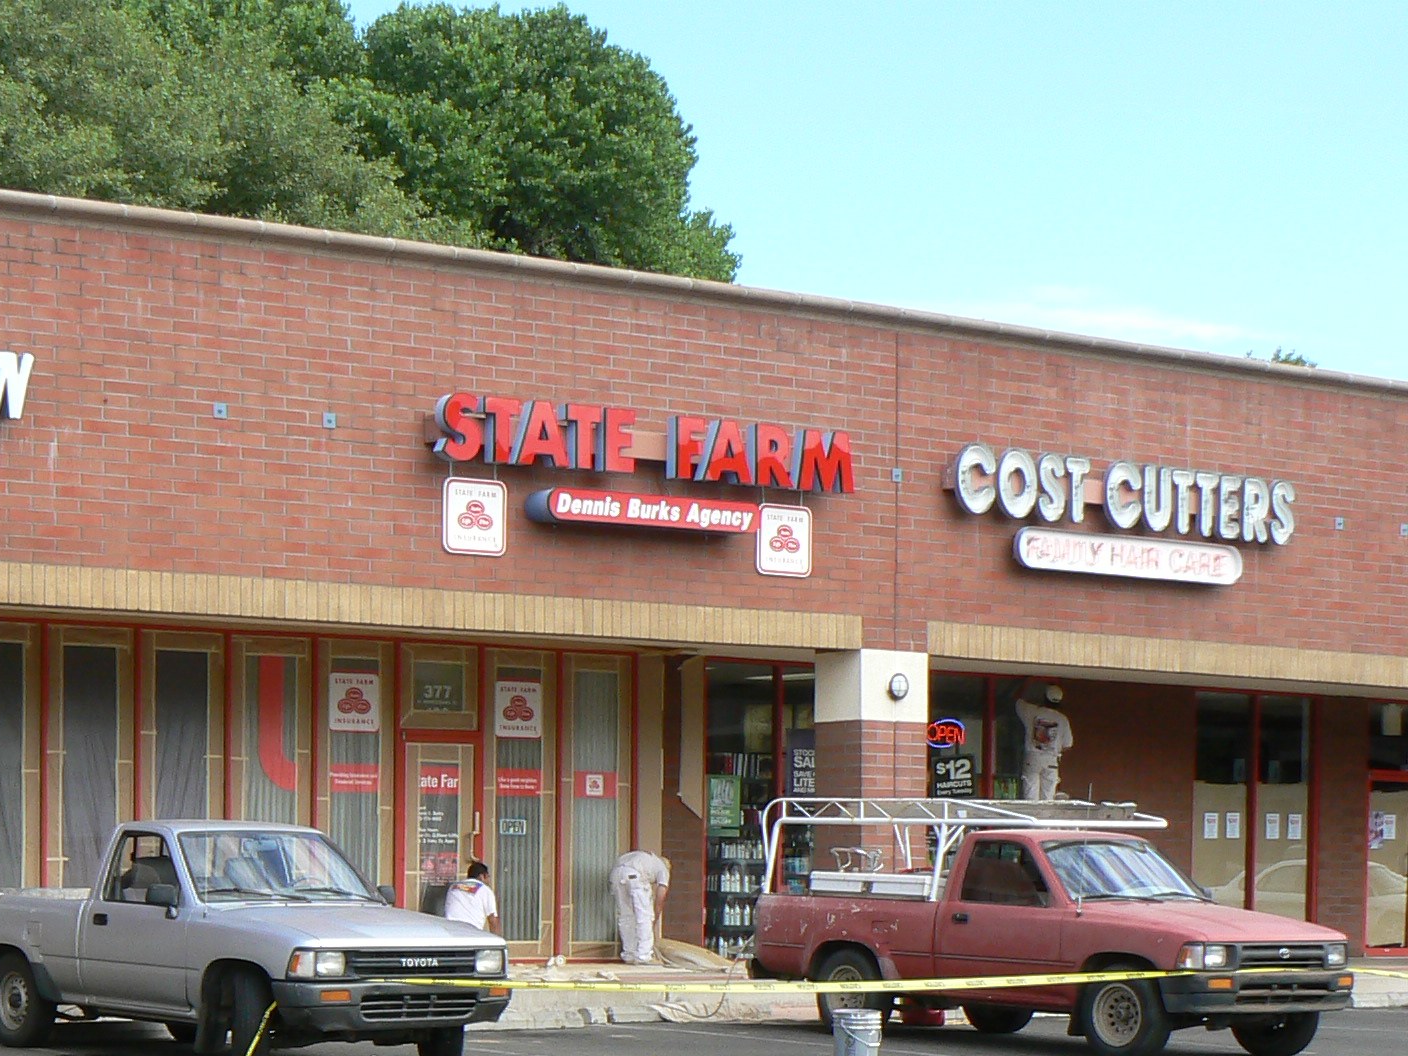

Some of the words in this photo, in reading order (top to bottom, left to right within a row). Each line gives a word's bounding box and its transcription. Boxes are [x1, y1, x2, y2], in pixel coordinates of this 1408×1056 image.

[438, 392, 636, 474] STATE
[668, 414, 855, 494] FARM
[954, 441, 1091, 524] COST
[1103, 459, 1296, 546] CUTTERS
[556, 492, 621, 517] Dennis
[626, 497, 681, 523] Burks
[686, 502, 754, 532] Agency
[1110, 541, 1159, 570] HAIR
[1169, 547, 1231, 578] CARE
[423, 684, 452, 700] 377
[927, 723, 966, 745] OPEN
[936, 757, 972, 780] $12
[936, 780, 973, 789] HAIRCUTS
[502, 820, 524, 834] OPEN
[400, 957, 440, 968] TOYOTA
